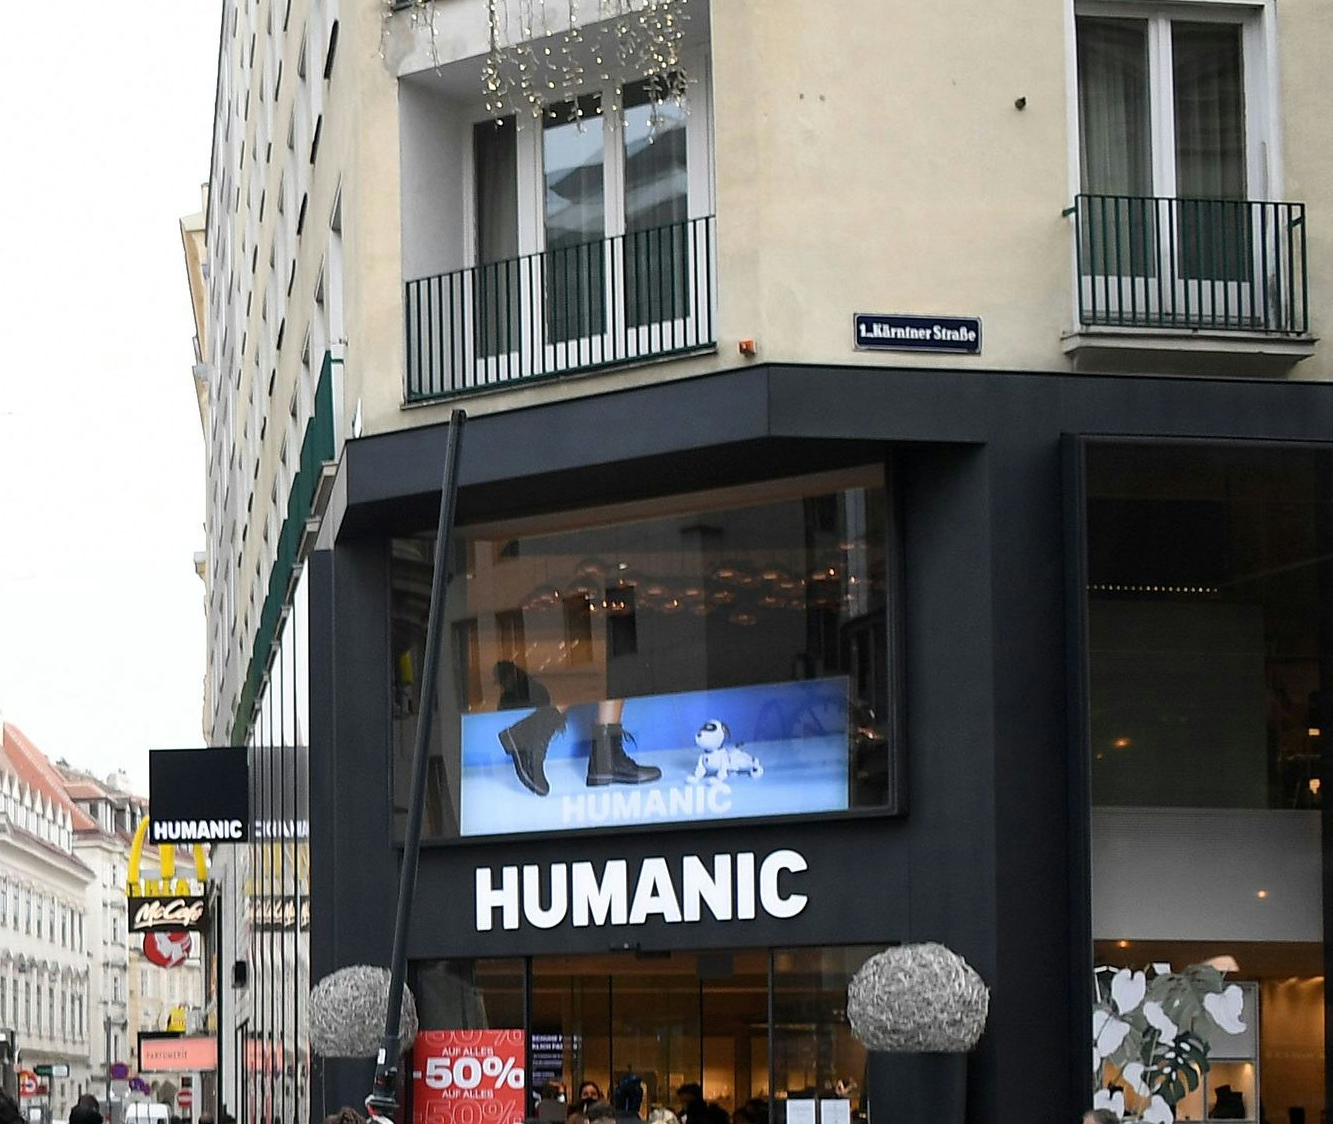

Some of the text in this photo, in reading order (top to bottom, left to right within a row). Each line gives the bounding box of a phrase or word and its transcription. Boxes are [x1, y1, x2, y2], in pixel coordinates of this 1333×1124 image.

[873, 322, 931, 340] Kärntner
[933, 325, 976, 342] Straße
[562, 782, 732, 824] HUMANIC
[154, 820, 242, 840] HUMANIC
[475, 849, 808, 931] HUMANIC
[442, 1047, 494, 1056] AUF ALLES
[413, 1056, 525, 1089] -50%
[442, 1089, 494, 1099] AUF ALLES
